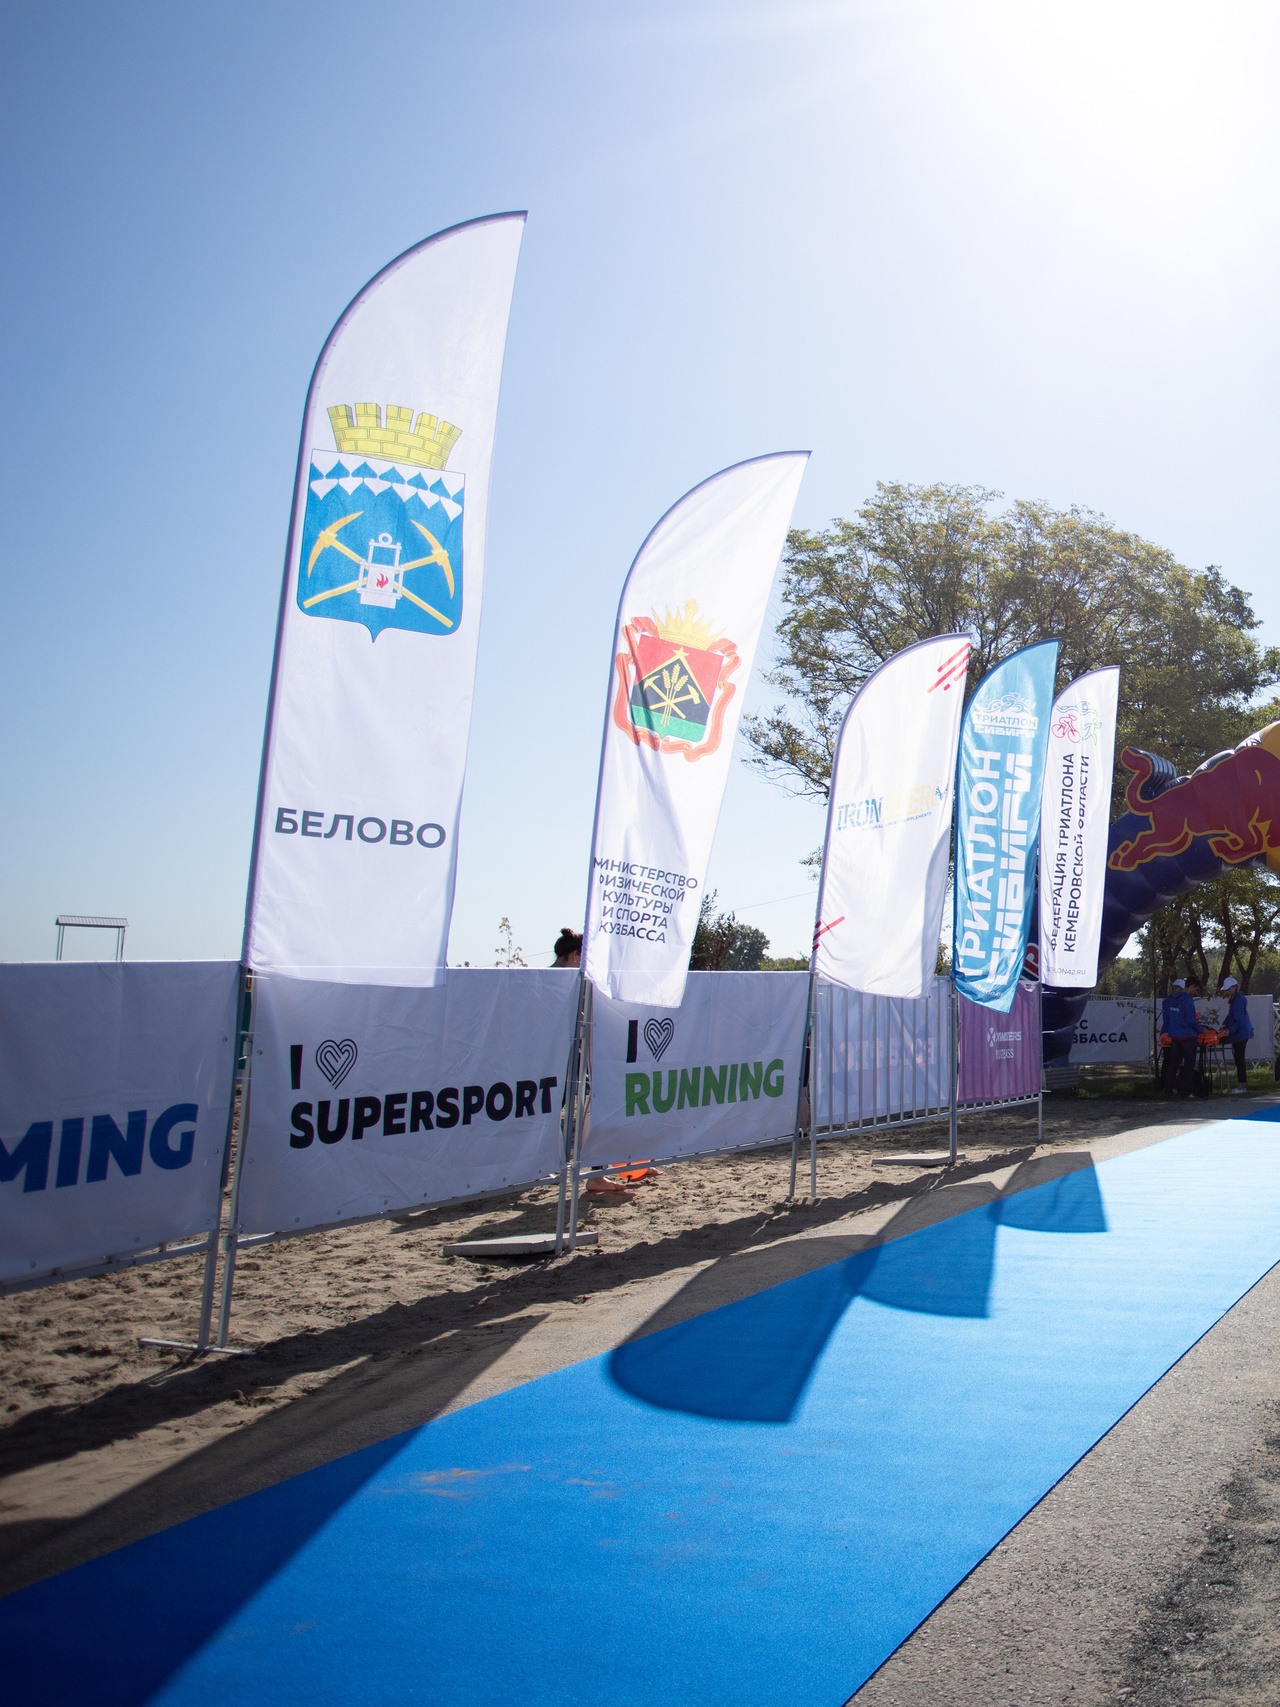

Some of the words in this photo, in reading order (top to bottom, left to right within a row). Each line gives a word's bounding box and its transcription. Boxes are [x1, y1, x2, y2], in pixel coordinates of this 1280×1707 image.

[976, 713, 1036, 728] ТРИАТЛОН
[1058, 753, 1075, 848] ТРИАТЛОНА
[274, 806, 447, 849] БЕЛОВО
[593, 857, 698, 888] МИНИСТЕРСТВО
[959, 749, 1001, 976] ТРИАТЛОН
[602, 890, 674, 914] КУЛЬТУРЫ
[1050, 852, 1067, 951] ФЕДЕРАЦИЯ
[1063, 833, 1084, 952] КЕМЕРОВСКОЙ
[598, 921, 666, 944] КУЗБАССА
[602, 905, 614, 918] И
[616, 907, 668, 929] СПОРТА
[626, 1019, 638, 1063] I
[1072, 1032, 1129, 1044] ЗБАССА
[290, 1044, 303, 1090] I
[625, 1058, 785, 1117] RUNNING
[289, 1077, 558, 1149] SUPERSPORT
[0, 1102, 199, 1193] MING
